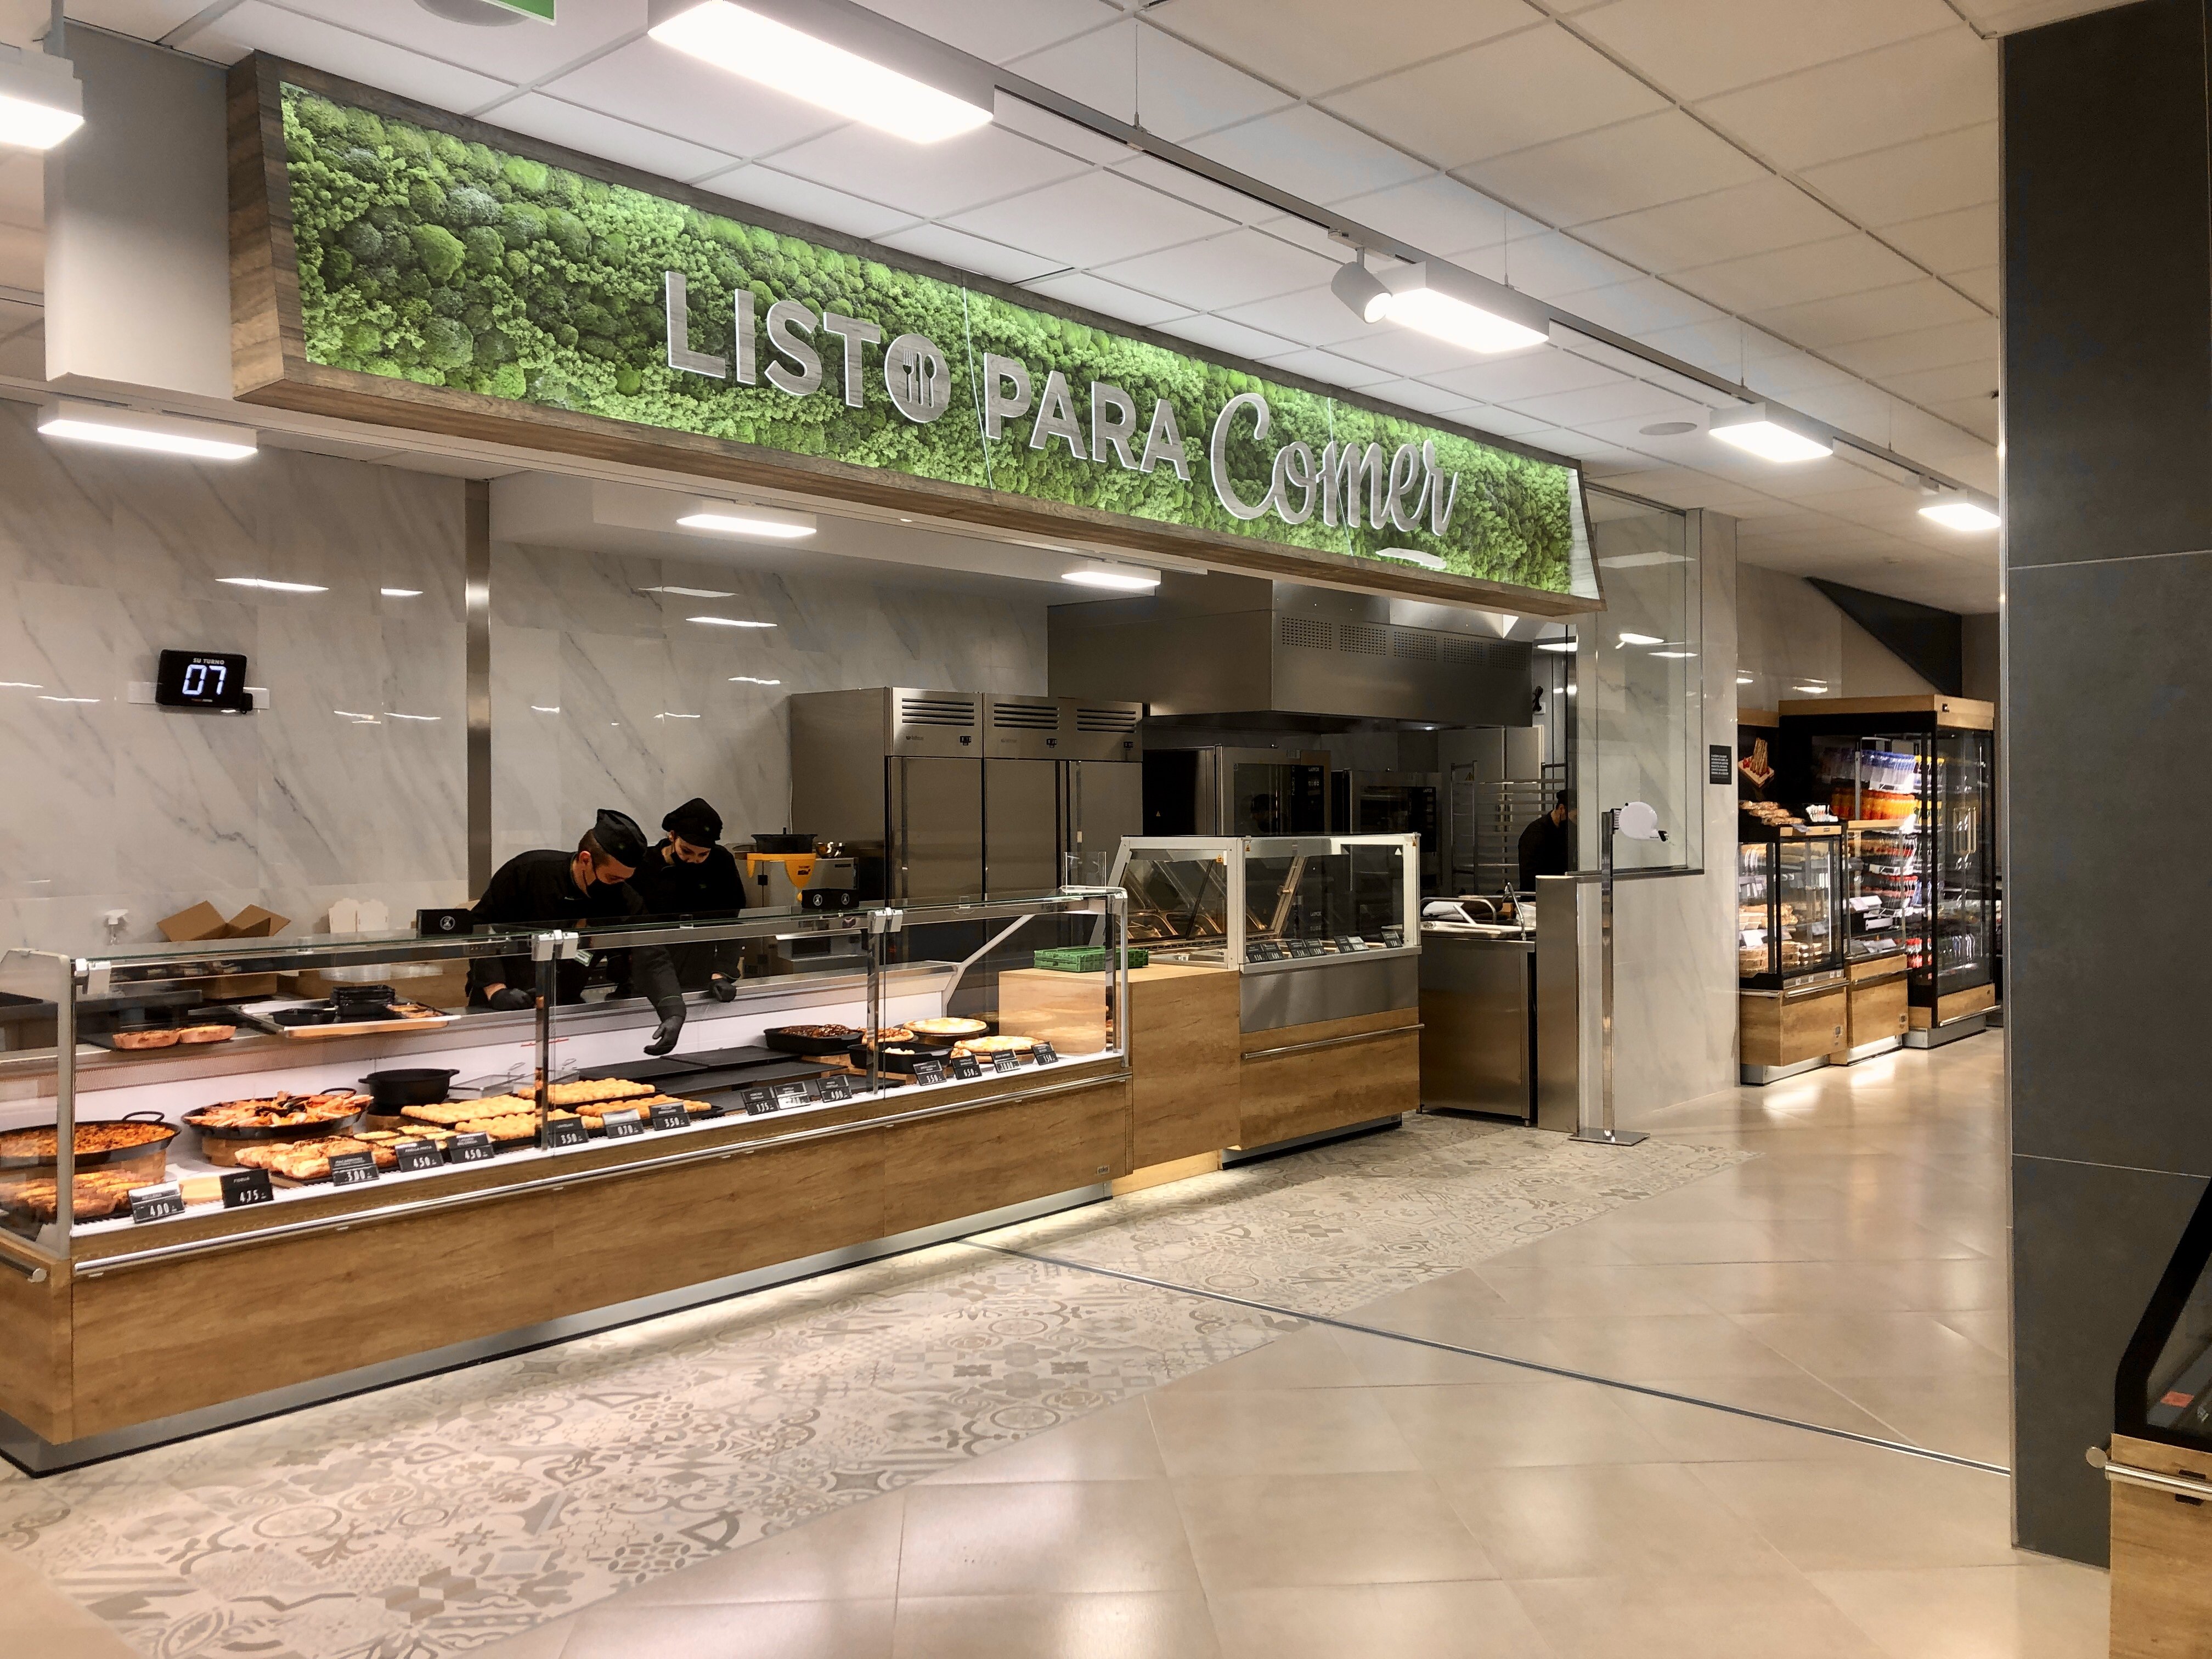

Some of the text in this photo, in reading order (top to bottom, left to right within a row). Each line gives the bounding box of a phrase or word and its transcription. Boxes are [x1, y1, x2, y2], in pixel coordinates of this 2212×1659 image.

[665, 270, 1458, 537] LISTO PARA Comer
[182, 664, 227, 696] 07
